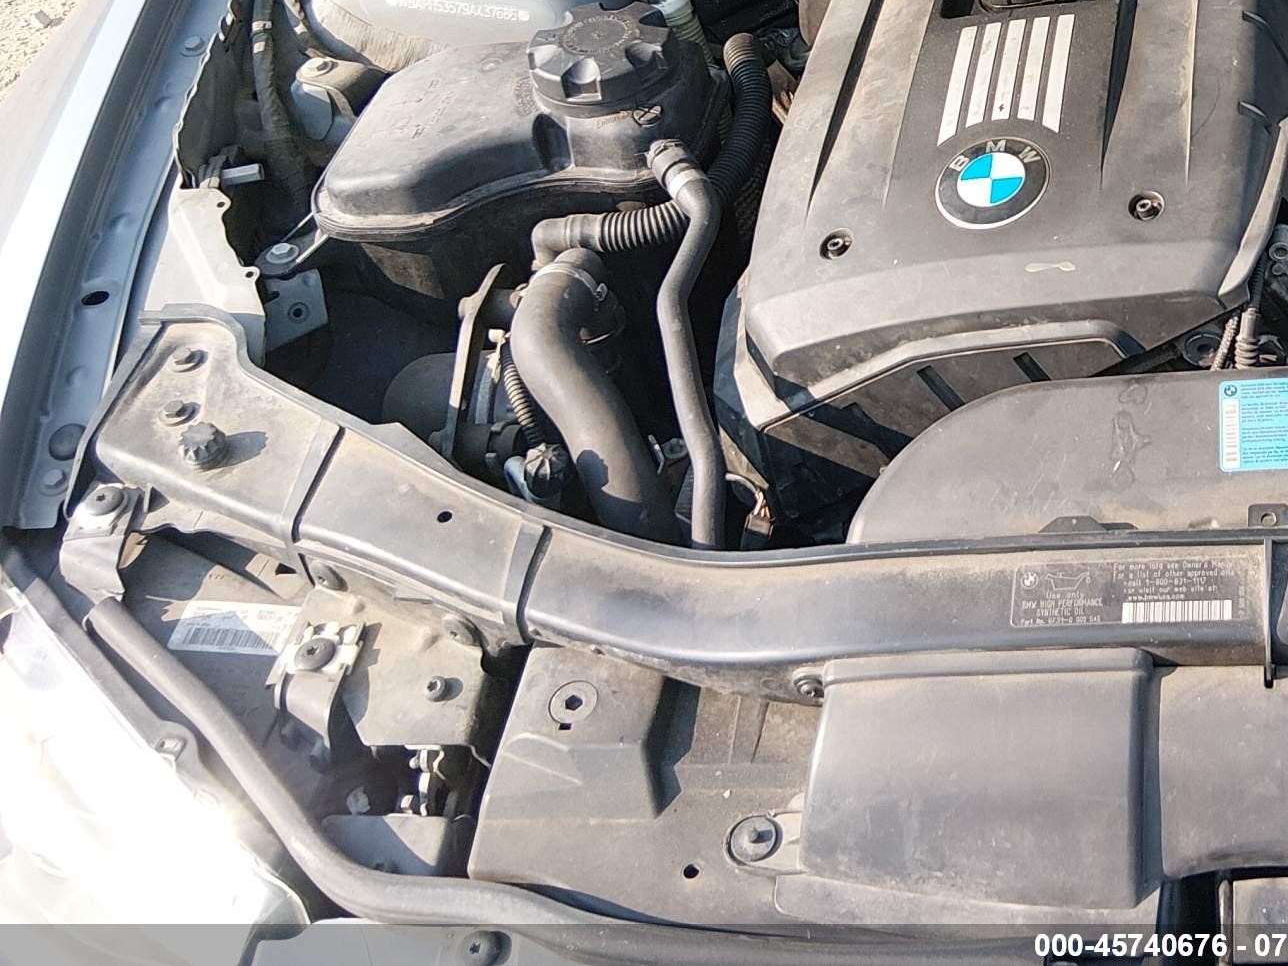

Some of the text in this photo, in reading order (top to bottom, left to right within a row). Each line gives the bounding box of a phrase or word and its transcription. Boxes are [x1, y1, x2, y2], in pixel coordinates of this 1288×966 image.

[949, 139, 1042, 172] BMW
[1114, 563, 1126, 571] For
[1149, 562, 1163, 570] info
[1137, 570, 1149, 578] list
[1165, 569, 1183, 577] other
[1187, 569, 1218, 577] approved
[1046, 590, 1085, 600] Use only
[1022, 597, 1104, 609] BMW HIGH PERFORMANCE
[1036, 607, 1085, 617] SYNTHETIC OIL
